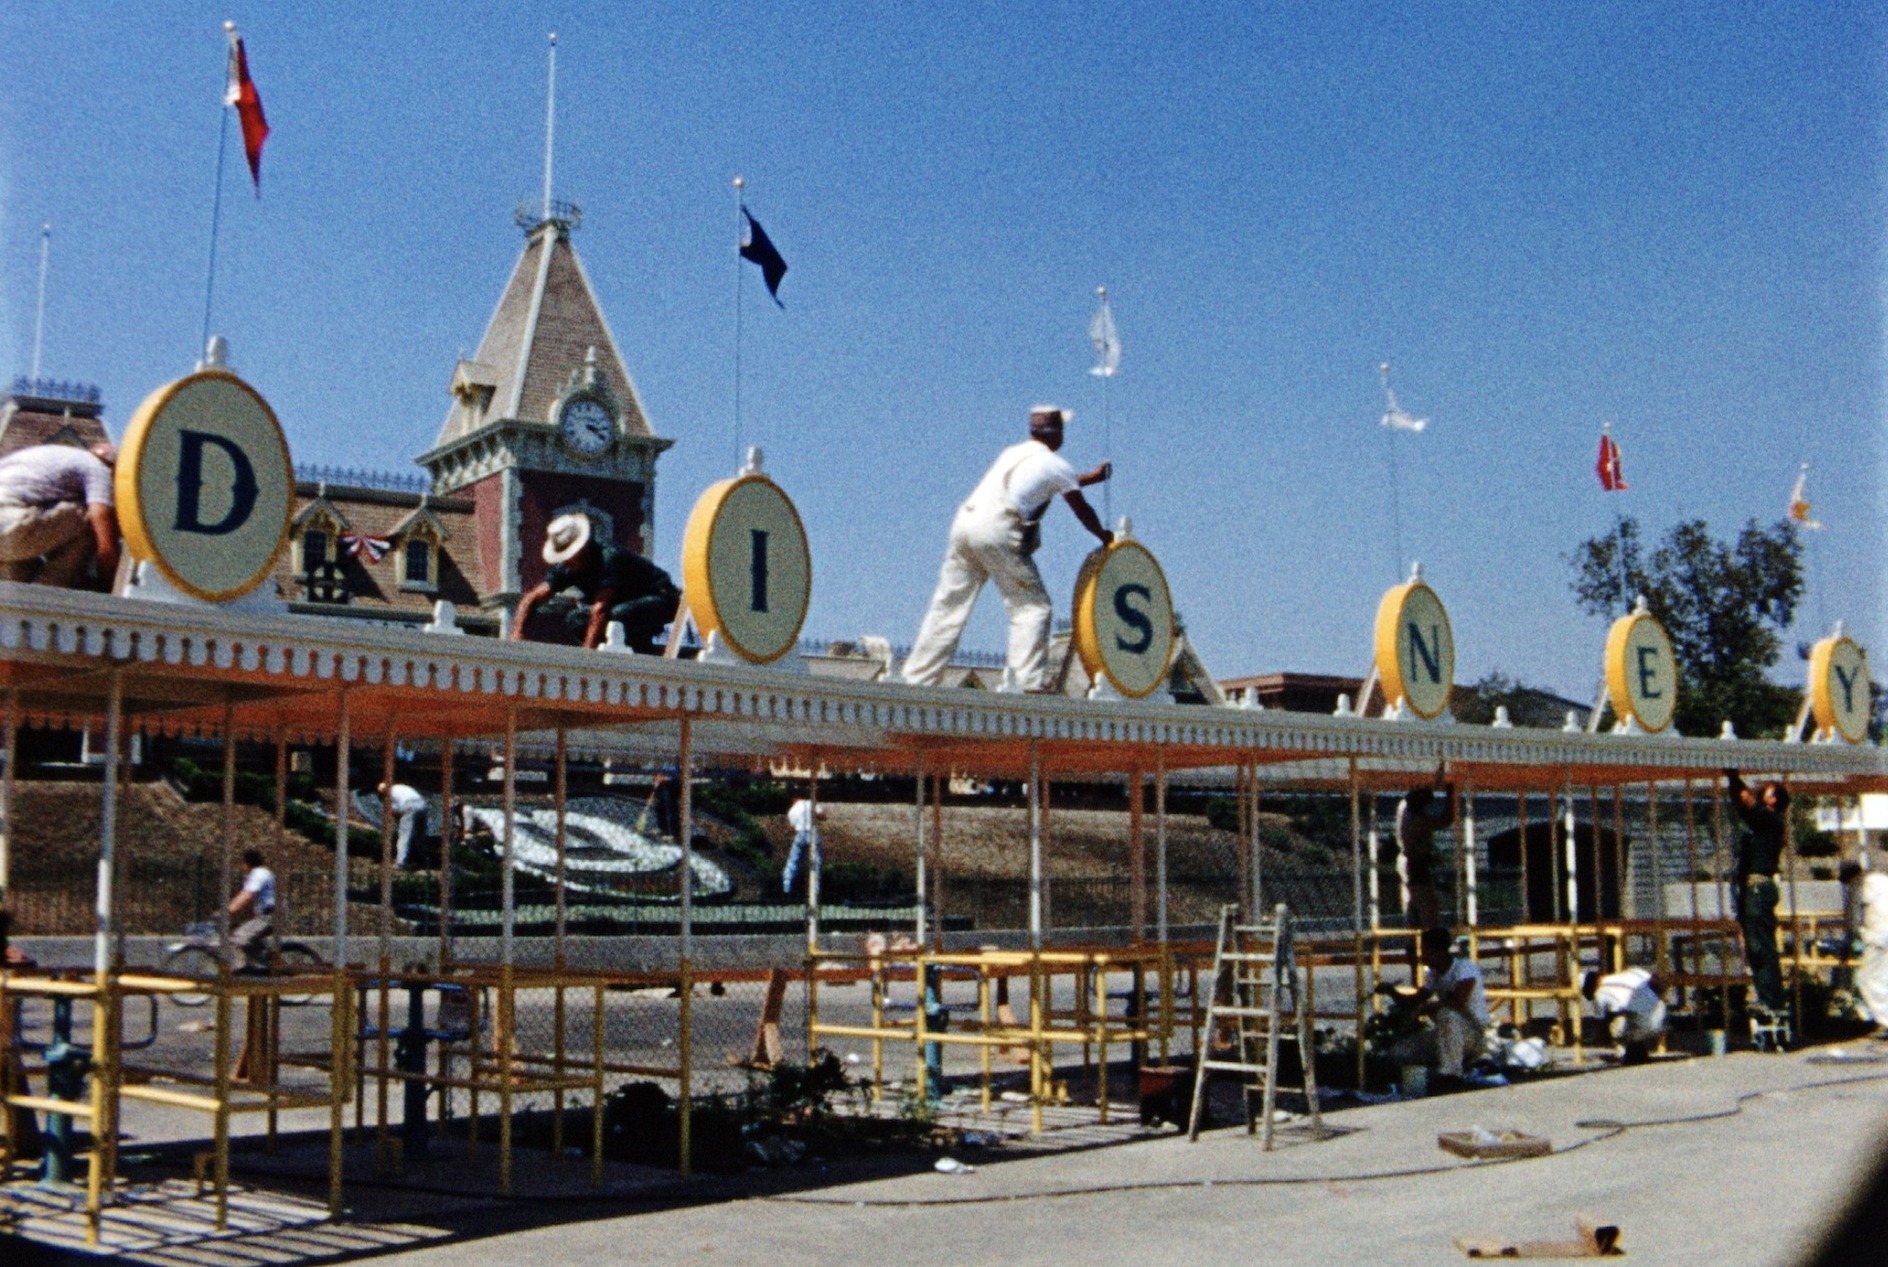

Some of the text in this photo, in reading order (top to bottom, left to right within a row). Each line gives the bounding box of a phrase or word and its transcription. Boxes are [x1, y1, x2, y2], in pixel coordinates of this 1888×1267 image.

[173, 428, 1859, 713] D I S N E Y
